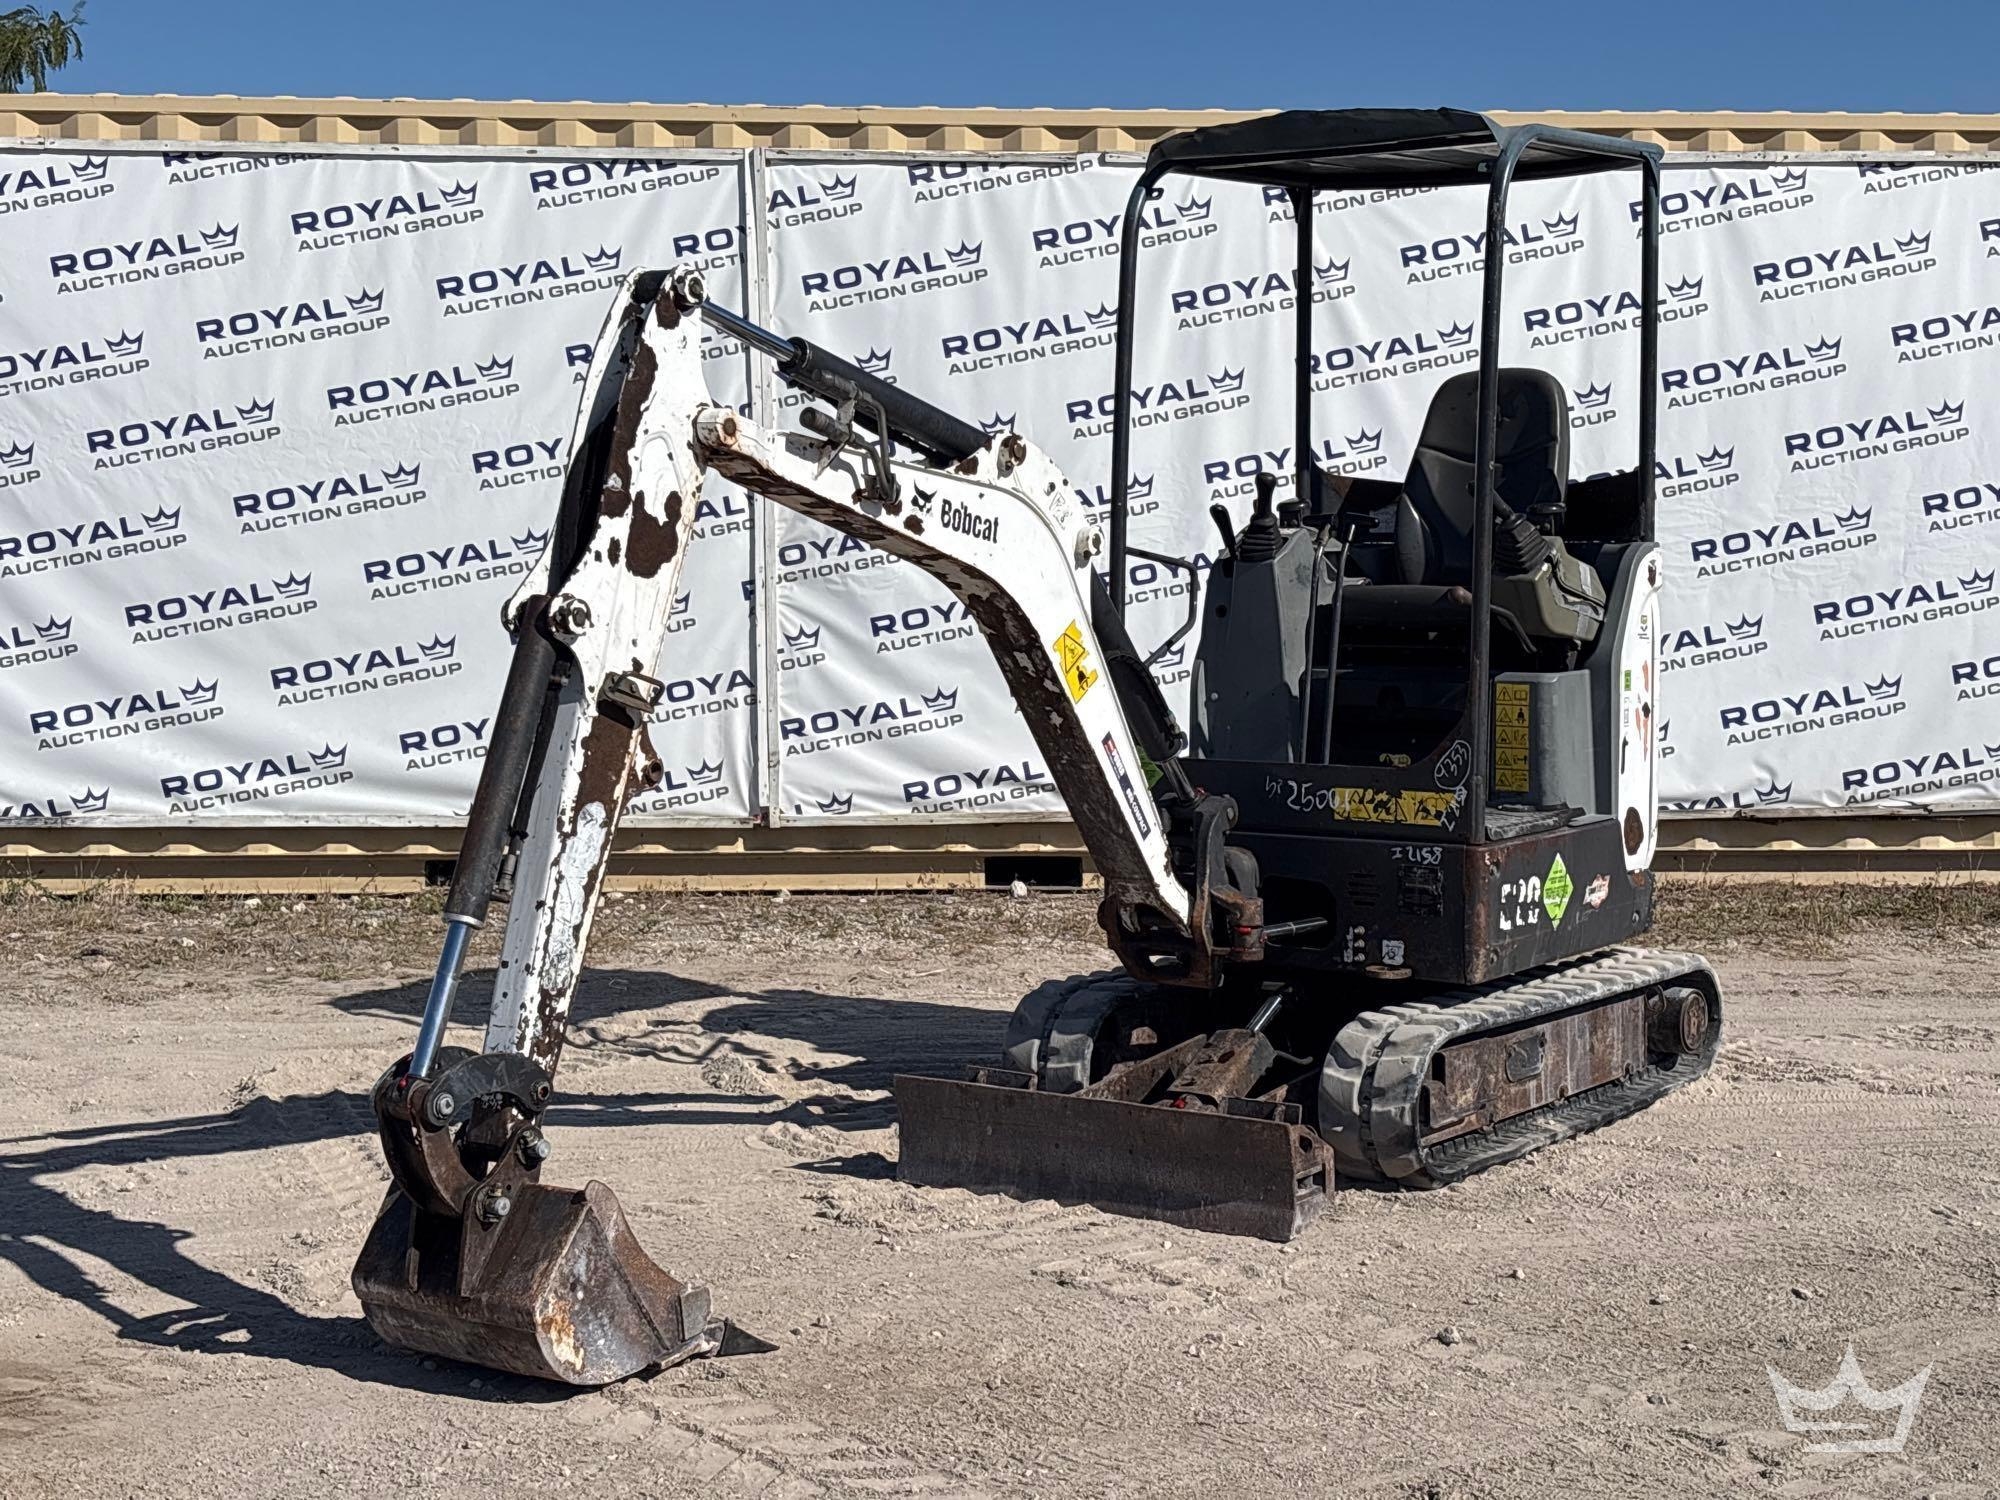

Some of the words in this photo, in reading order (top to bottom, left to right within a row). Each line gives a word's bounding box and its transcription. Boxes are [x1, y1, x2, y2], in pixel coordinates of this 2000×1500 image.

[168, 157, 271, 185] AUCTION
[537, 182, 636, 210] AUCTION
[641, 168, 719, 191] GROUP
[915, 175, 1012, 203] AUCTION
[1016, 160, 1094, 184] GROUP
[1864, 166, 1959, 194] AUCTION
[34, 184, 114, 207] GROUP
[291, 192, 441, 235] ROYAL
[785, 203, 862, 226] GROUP
[1738, 195, 1813, 218] GROUP
[299, 224, 399, 252] AUCTION
[405, 210, 483, 233] GROUP
[1040, 243, 1120, 269] AUCTIO
[1142, 224, 1217, 248] GROUP
[50, 234, 201, 277] ROYAL
[57, 267, 159, 294] AUCTION
[165, 252, 244, 275] GROUP
[802, 252, 946, 296] ROYAL
[1407, 260, 1485, 285] AUCTIO
[1509, 240, 1584, 264] GROUP
[1753, 242, 1896, 286] ROYAL
[436, 257, 585, 299] ROYAL
[809, 284, 906, 312] AUCTION
[911, 269, 988, 293] GROUP
[1760, 274, 1856, 302] AUCTION
[1861, 258, 1936, 282] GROUP
[196, 299, 347, 342] ROYAL
[444, 289, 544, 317] AUCTION
[1178, 301, 1274, 330] AUCTION
[1280, 285, 1356, 310] GOUP
[204, 331, 305, 359] AUCTION
[310, 317, 390, 340] GROUP
[942, 314, 1085, 358] ROYAL
[1531, 319, 1627, 348] AUCTION
[1891, 305, 2000, 347] ROYA
[0, 342, 106, 380] OYAL
[949, 346, 1046, 375] AUCTION
[1051, 331, 1117, 356] GROU
[1403, 349, 1479, 373] GROUP
[1661, 348, 1805, 392] ROYAL
[1898, 335, 1994, 364] AUCTION
[0, 374, 64, 396] CTION
[69, 359, 149, 383] GROUP
[327, 367, 476, 410] ROYAL
[1668, 380, 1765, 409] AUCTION
[1770, 364, 1846, 388] GROUP
[335, 399, 435, 427] AUCTION
[441, 384, 519, 407] GROUP
[1073, 411, 1170, 440] AUCION
[1174, 395, 1250, 419] GROUP
[1571, 410, 1617, 429] OUP
[87, 409, 237, 453] ROYAL
[95, 442, 195, 470] AUCTION
[201, 427, 280, 450] GROUP
[1785, 412, 1928, 456] ROYAL
[1791, 443, 1888, 472] AUCTION
[1893, 428, 1969, 452] GROUP
[472, 437, 563, 475] ROY
[233, 474, 383, 517] ROYAL
[480, 466, 564, 492] AUCTIO
[1662, 473, 1739, 497] GROUP
[241, 506, 342, 534] AUCTION
[347, 491, 426, 514] GROUP
[941, 498, 999, 544] Bobcat
[0, 517, 143, 560] ROYAL
[1, 550, 102, 578] AUCTION
[107, 534, 186, 558] GROUP
[779, 534, 866, 566] OYA
[1691, 518, 1835, 562] ROYAL
[1697, 550, 1794, 578] AUCTION
[1800, 534, 1877, 558] GROUP
[364, 540, 512, 583] ROYAL
[371, 572, 471, 600] AUCTION
[475, 558, 539, 582] GROU
[855, 553, 901, 571] GRO
[125, 584, 274, 627] ROYAL
[133, 616, 233, 644] AUCTION
[238, 600, 317, 624] GROUP
[1814, 581, 1959, 624] ROYAL
[1820, 612, 1918, 641] AUCTION
[1923, 597, 1999, 620] GROUP
[0, 644, 78, 668] GROUP
[877, 625, 973, 654] AUCTION
[1691, 642, 1767, 666] GROUP
[270, 646, 419, 689] ROYAL
[780, 653, 826, 671] OUP
[278, 678, 378, 706] AUCTION
[383, 663, 462, 686] GROUP
[30, 690, 180, 734] ROYAL
[38, 722, 140, 750] AUCTION
[145, 707, 223, 730] GROUP
[780, 698, 922, 740] ROYAL
[1720, 686, 1865, 729] ROYAL
[1727, 717, 1824, 746] AUCTION
[1830, 702, 1906, 725] GROUP
[399, 718, 490, 755] ROY
[787, 729, 883, 757] AUCTION
[887, 714, 963, 737] GROUP
[161, 755, 311, 798] ROYAL
[406, 746, 489, 772] AUCTIO
[1842, 748, 1984, 791] ROYAL
[169, 787, 269, 814] AUCTION
[274, 771, 353, 795] GROUP
[652, 786, 729, 810] GROUP
[902, 760, 1045, 803] ROYAL
[1010, 782, 1056, 800] GRO
[1845, 780, 1943, 806] AUCTION
